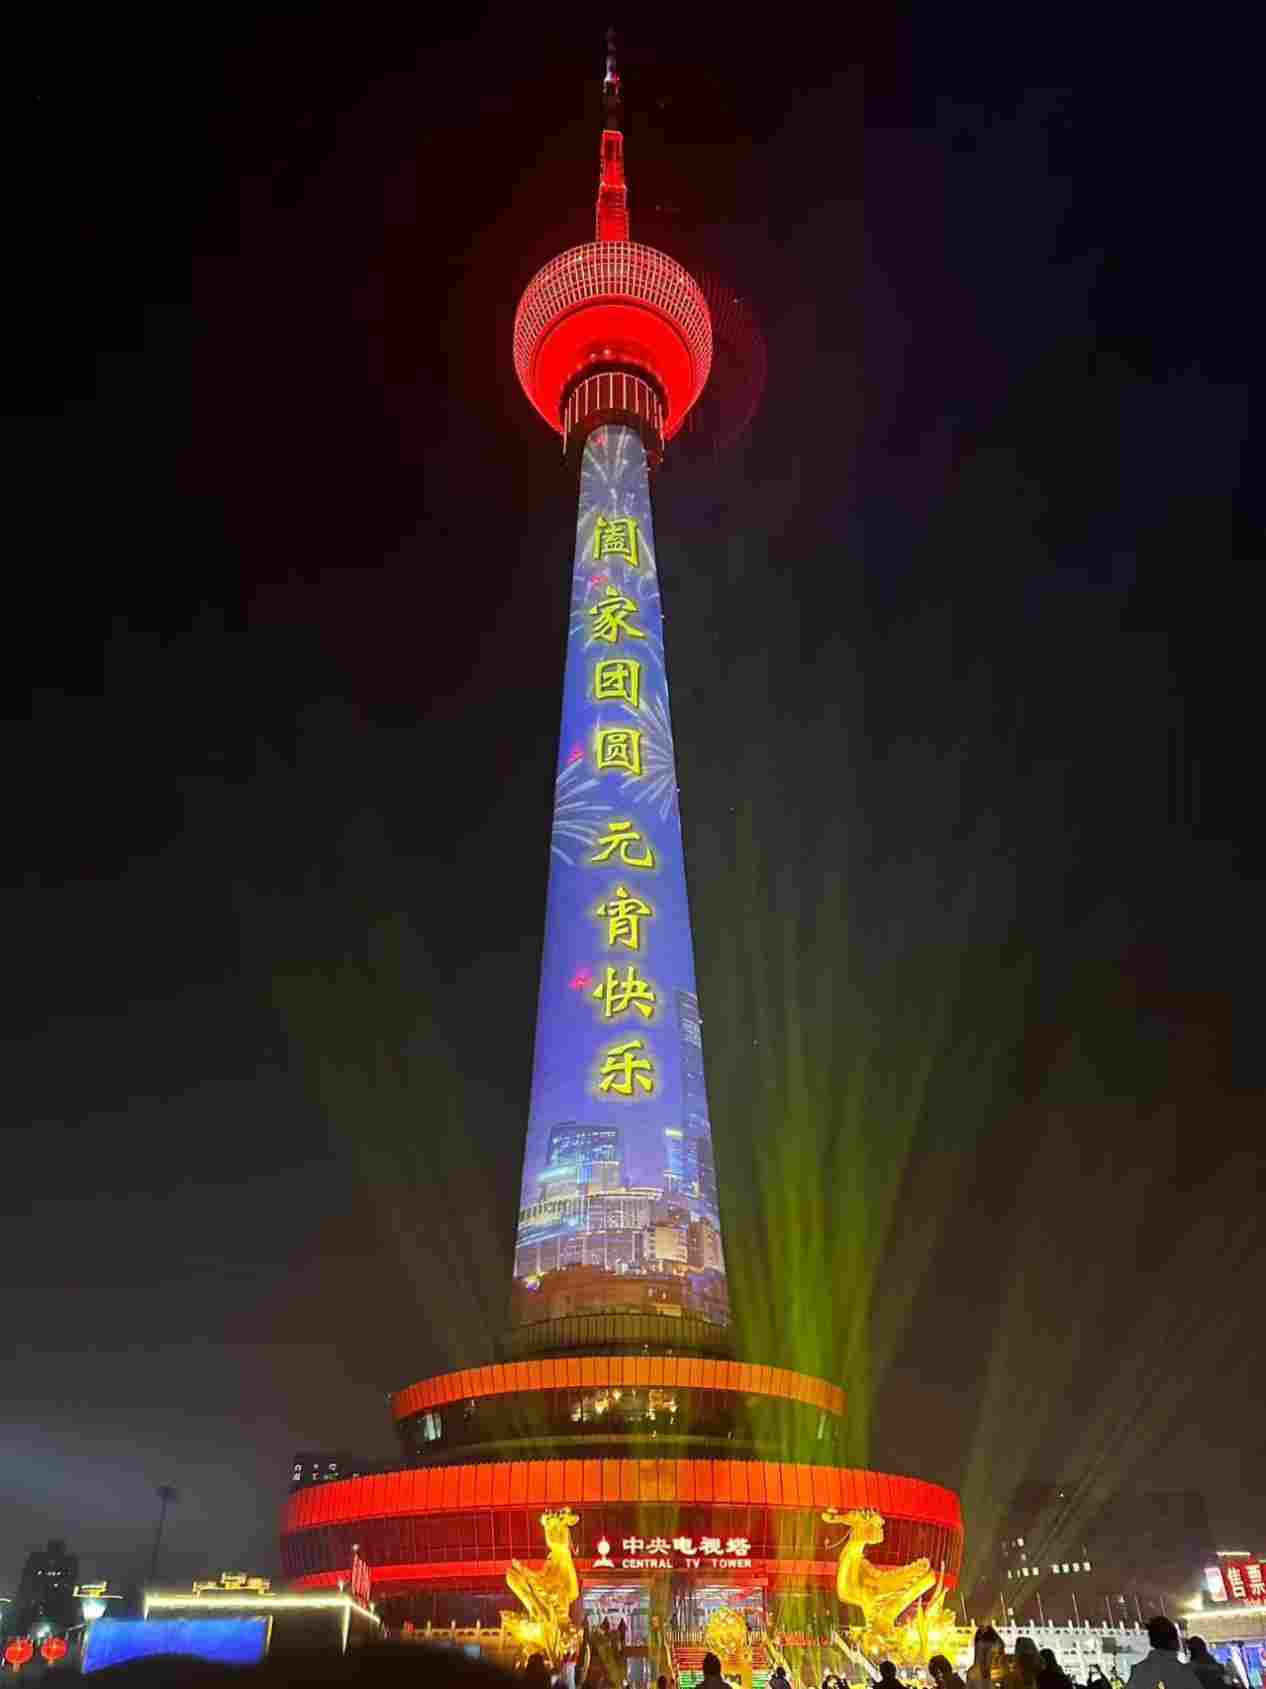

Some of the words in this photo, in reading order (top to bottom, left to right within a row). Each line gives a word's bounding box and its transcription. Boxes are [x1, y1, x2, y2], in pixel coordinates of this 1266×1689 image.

[589, 515, 645, 777] 阖家团圆
[592, 820, 655, 1095] 元宵快乐
[622, 1536, 752, 1556] 中央电视塔
[622, 1558, 673, 1568] CENTRAL
[686, 1558, 700, 1568] TV
[712, 1558, 752, 1568] TOWER
